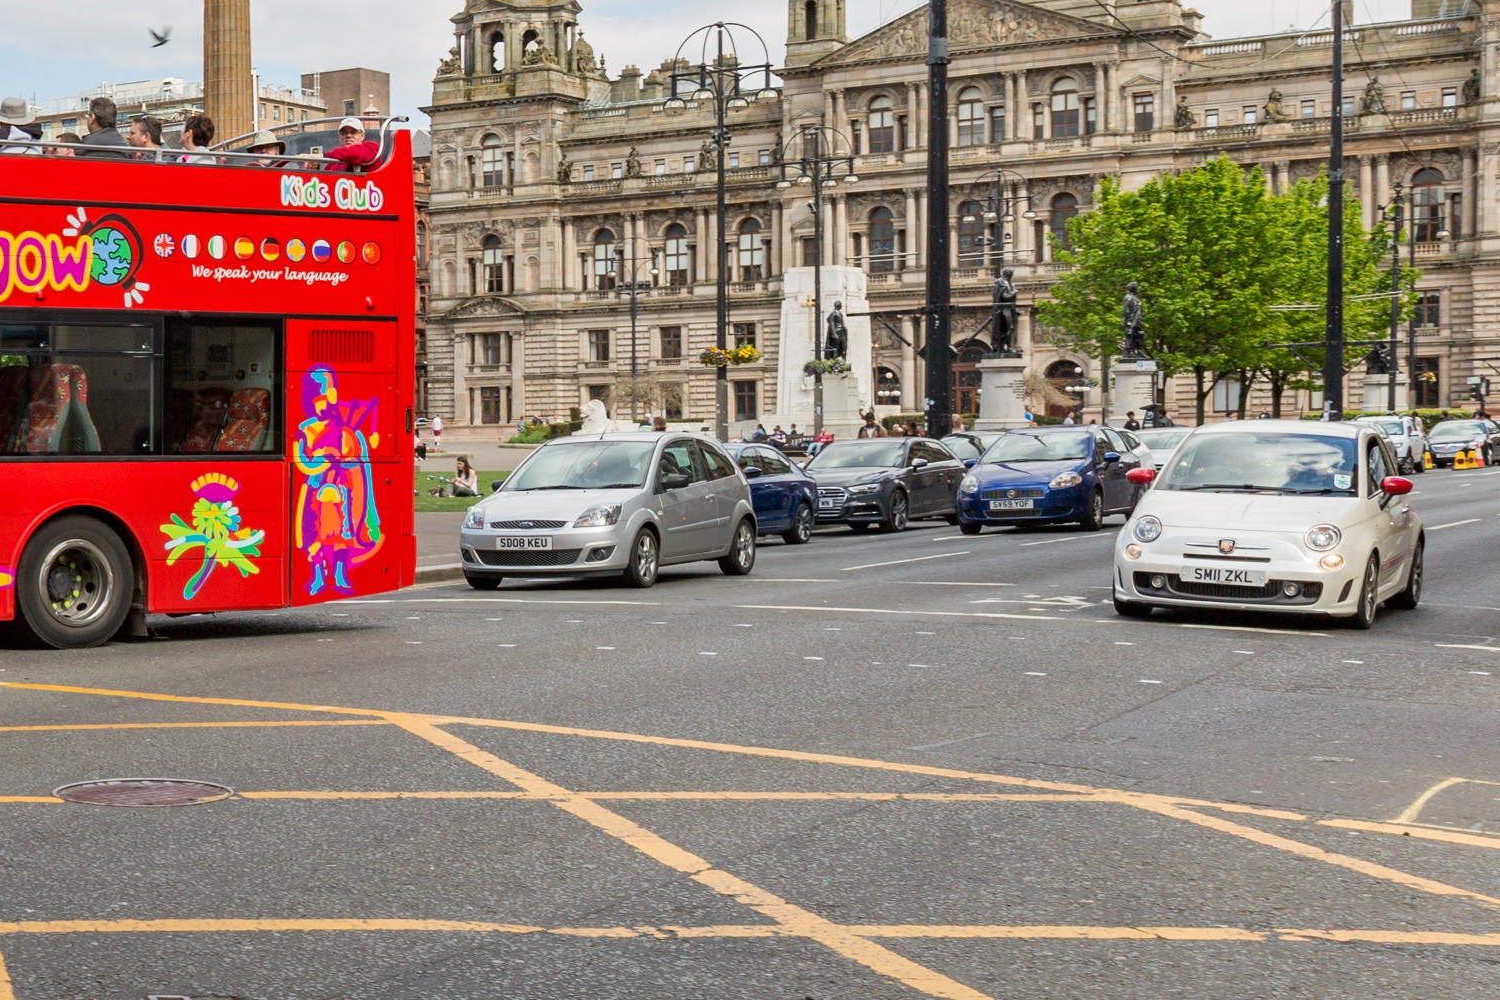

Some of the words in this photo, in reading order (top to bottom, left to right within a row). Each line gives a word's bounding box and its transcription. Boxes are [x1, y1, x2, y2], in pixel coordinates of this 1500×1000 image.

[281, 175, 330, 206] Kids
[335, 178, 383, 211] Club
[192, 264, 212, 278] We
[211, 265, 251, 282] speak
[250, 269, 282, 283] your
[284, 266, 348, 286] language
[500, 538, 524, 548] SD08
[528, 538, 548, 548] KEU
[1194, 568, 1220, 580] SM11
[1225, 570, 1253, 583] ZKL
